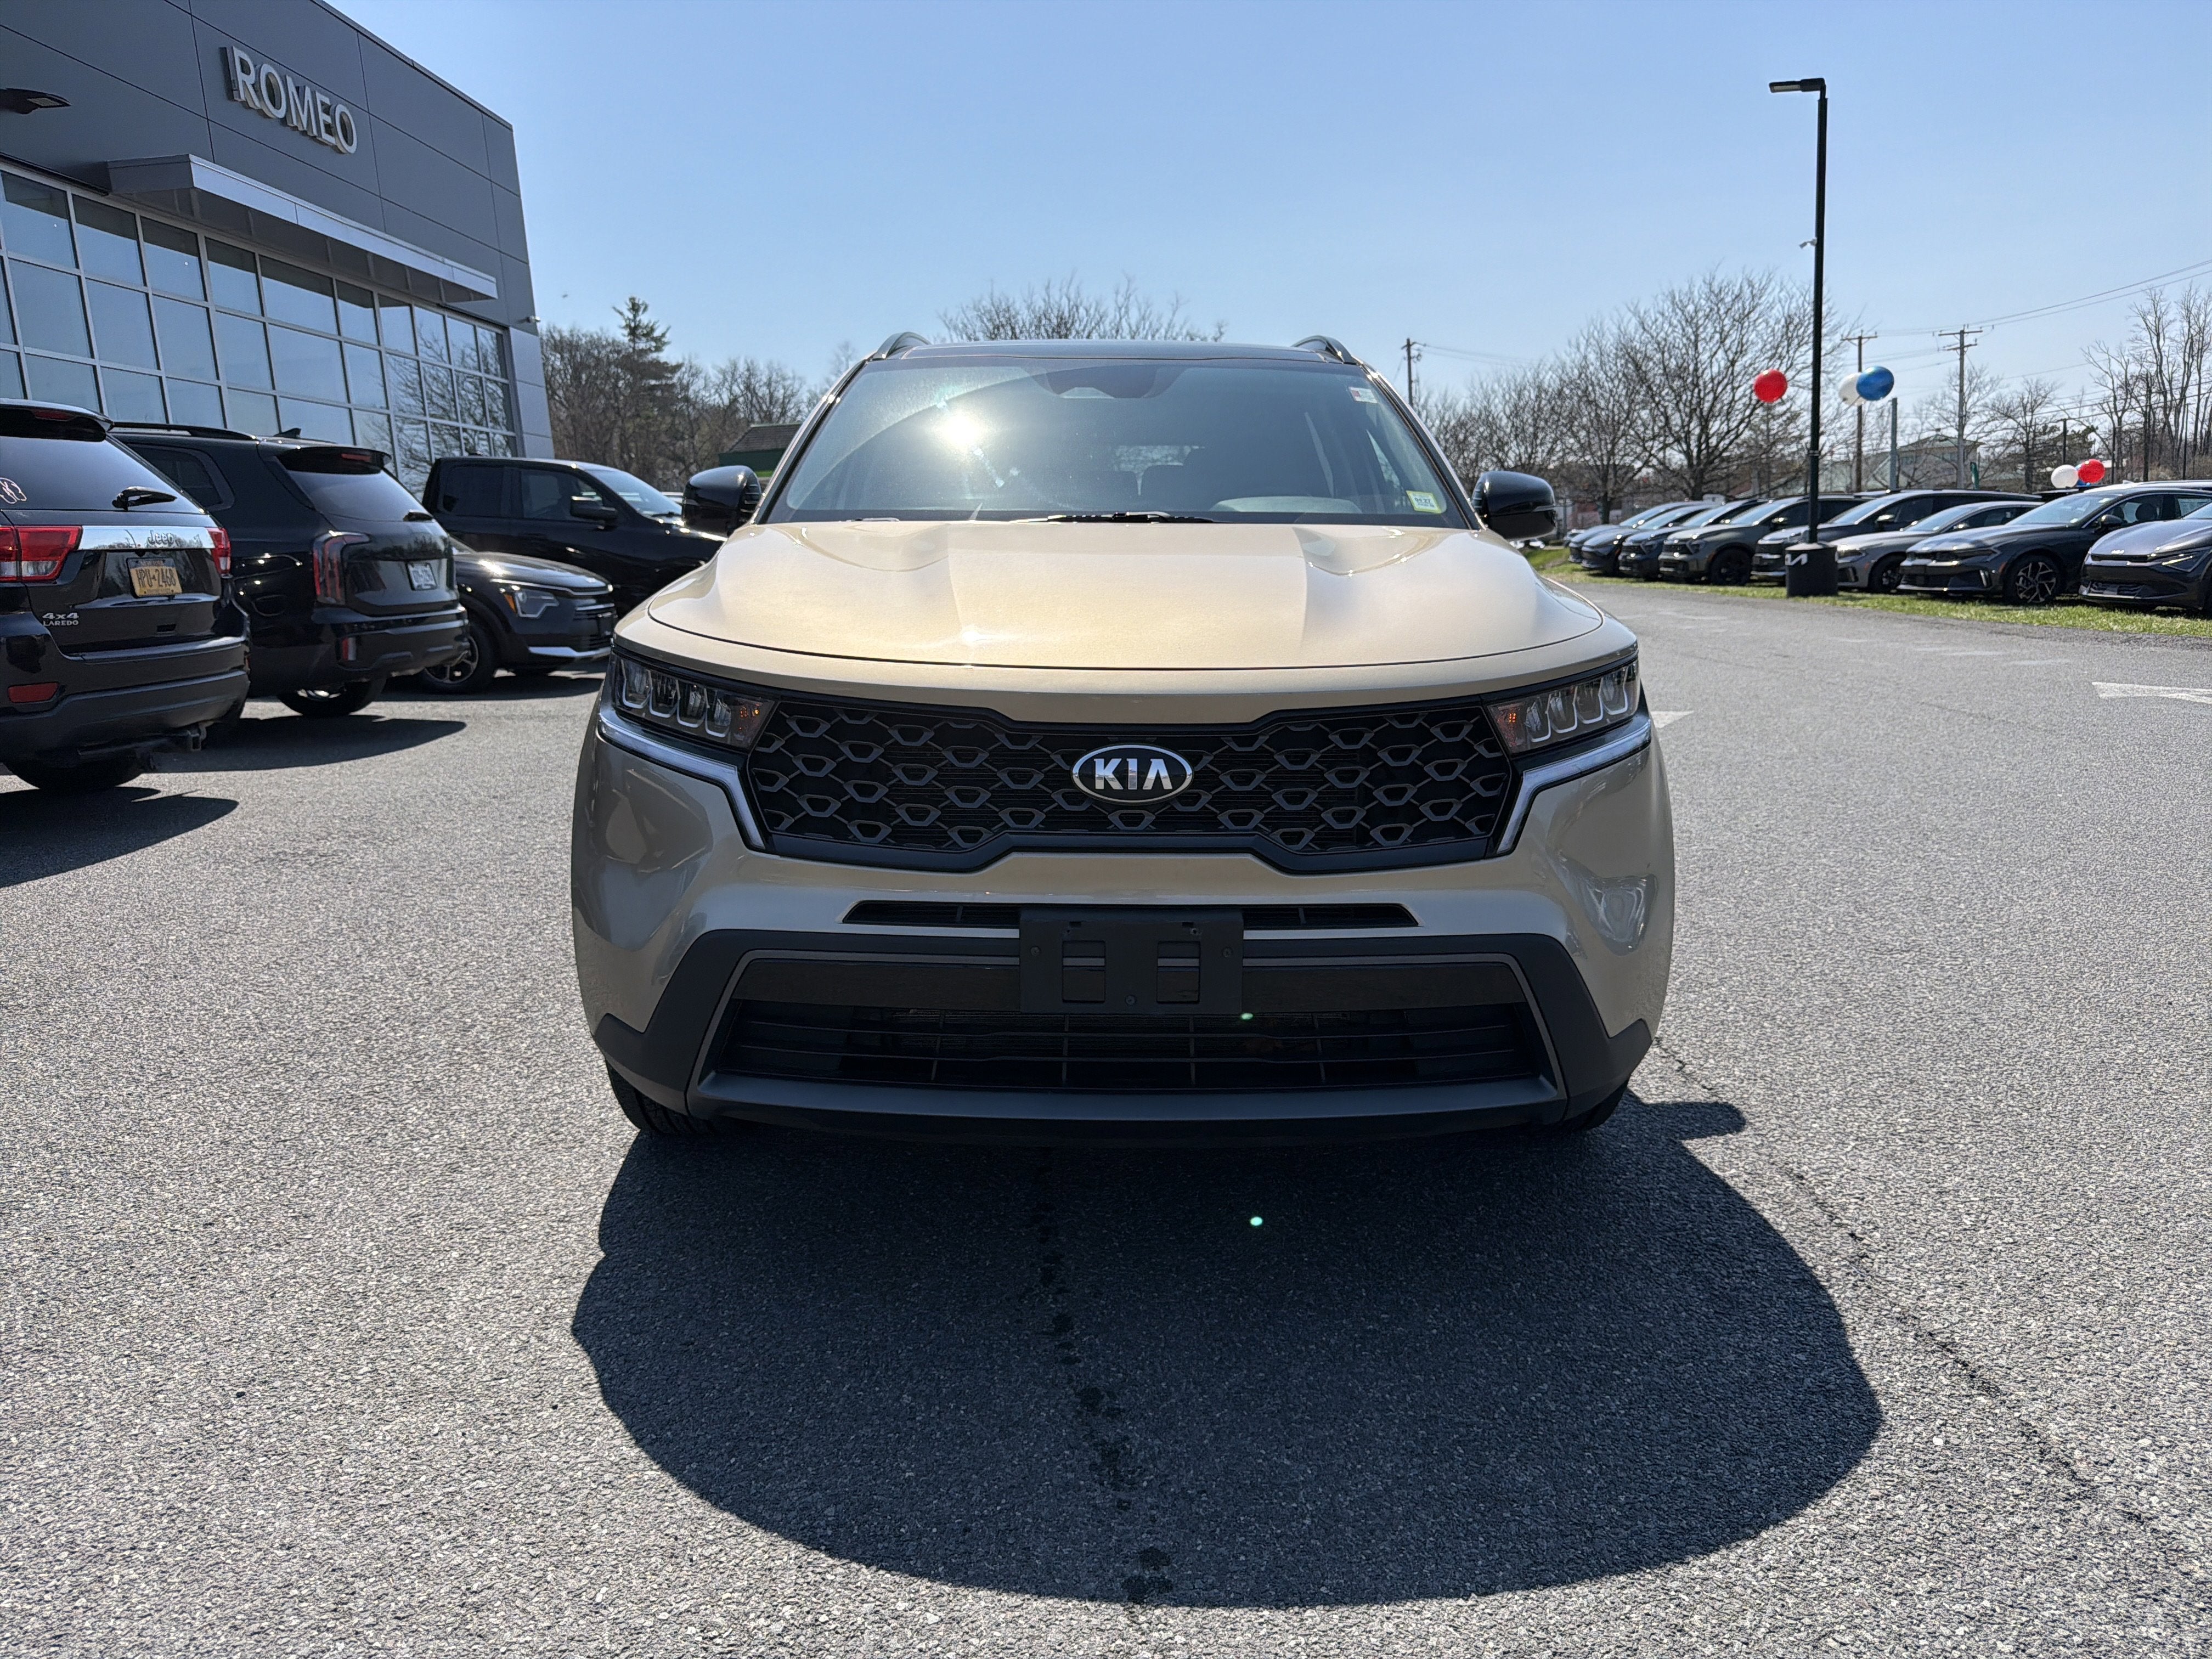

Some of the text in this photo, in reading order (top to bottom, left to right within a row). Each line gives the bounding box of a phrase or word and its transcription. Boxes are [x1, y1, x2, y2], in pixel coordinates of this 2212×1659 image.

[229, 46, 357, 154] ROMEO
[147, 530, 174, 547] Jeep
[1093, 758, 1173, 790] KIA
